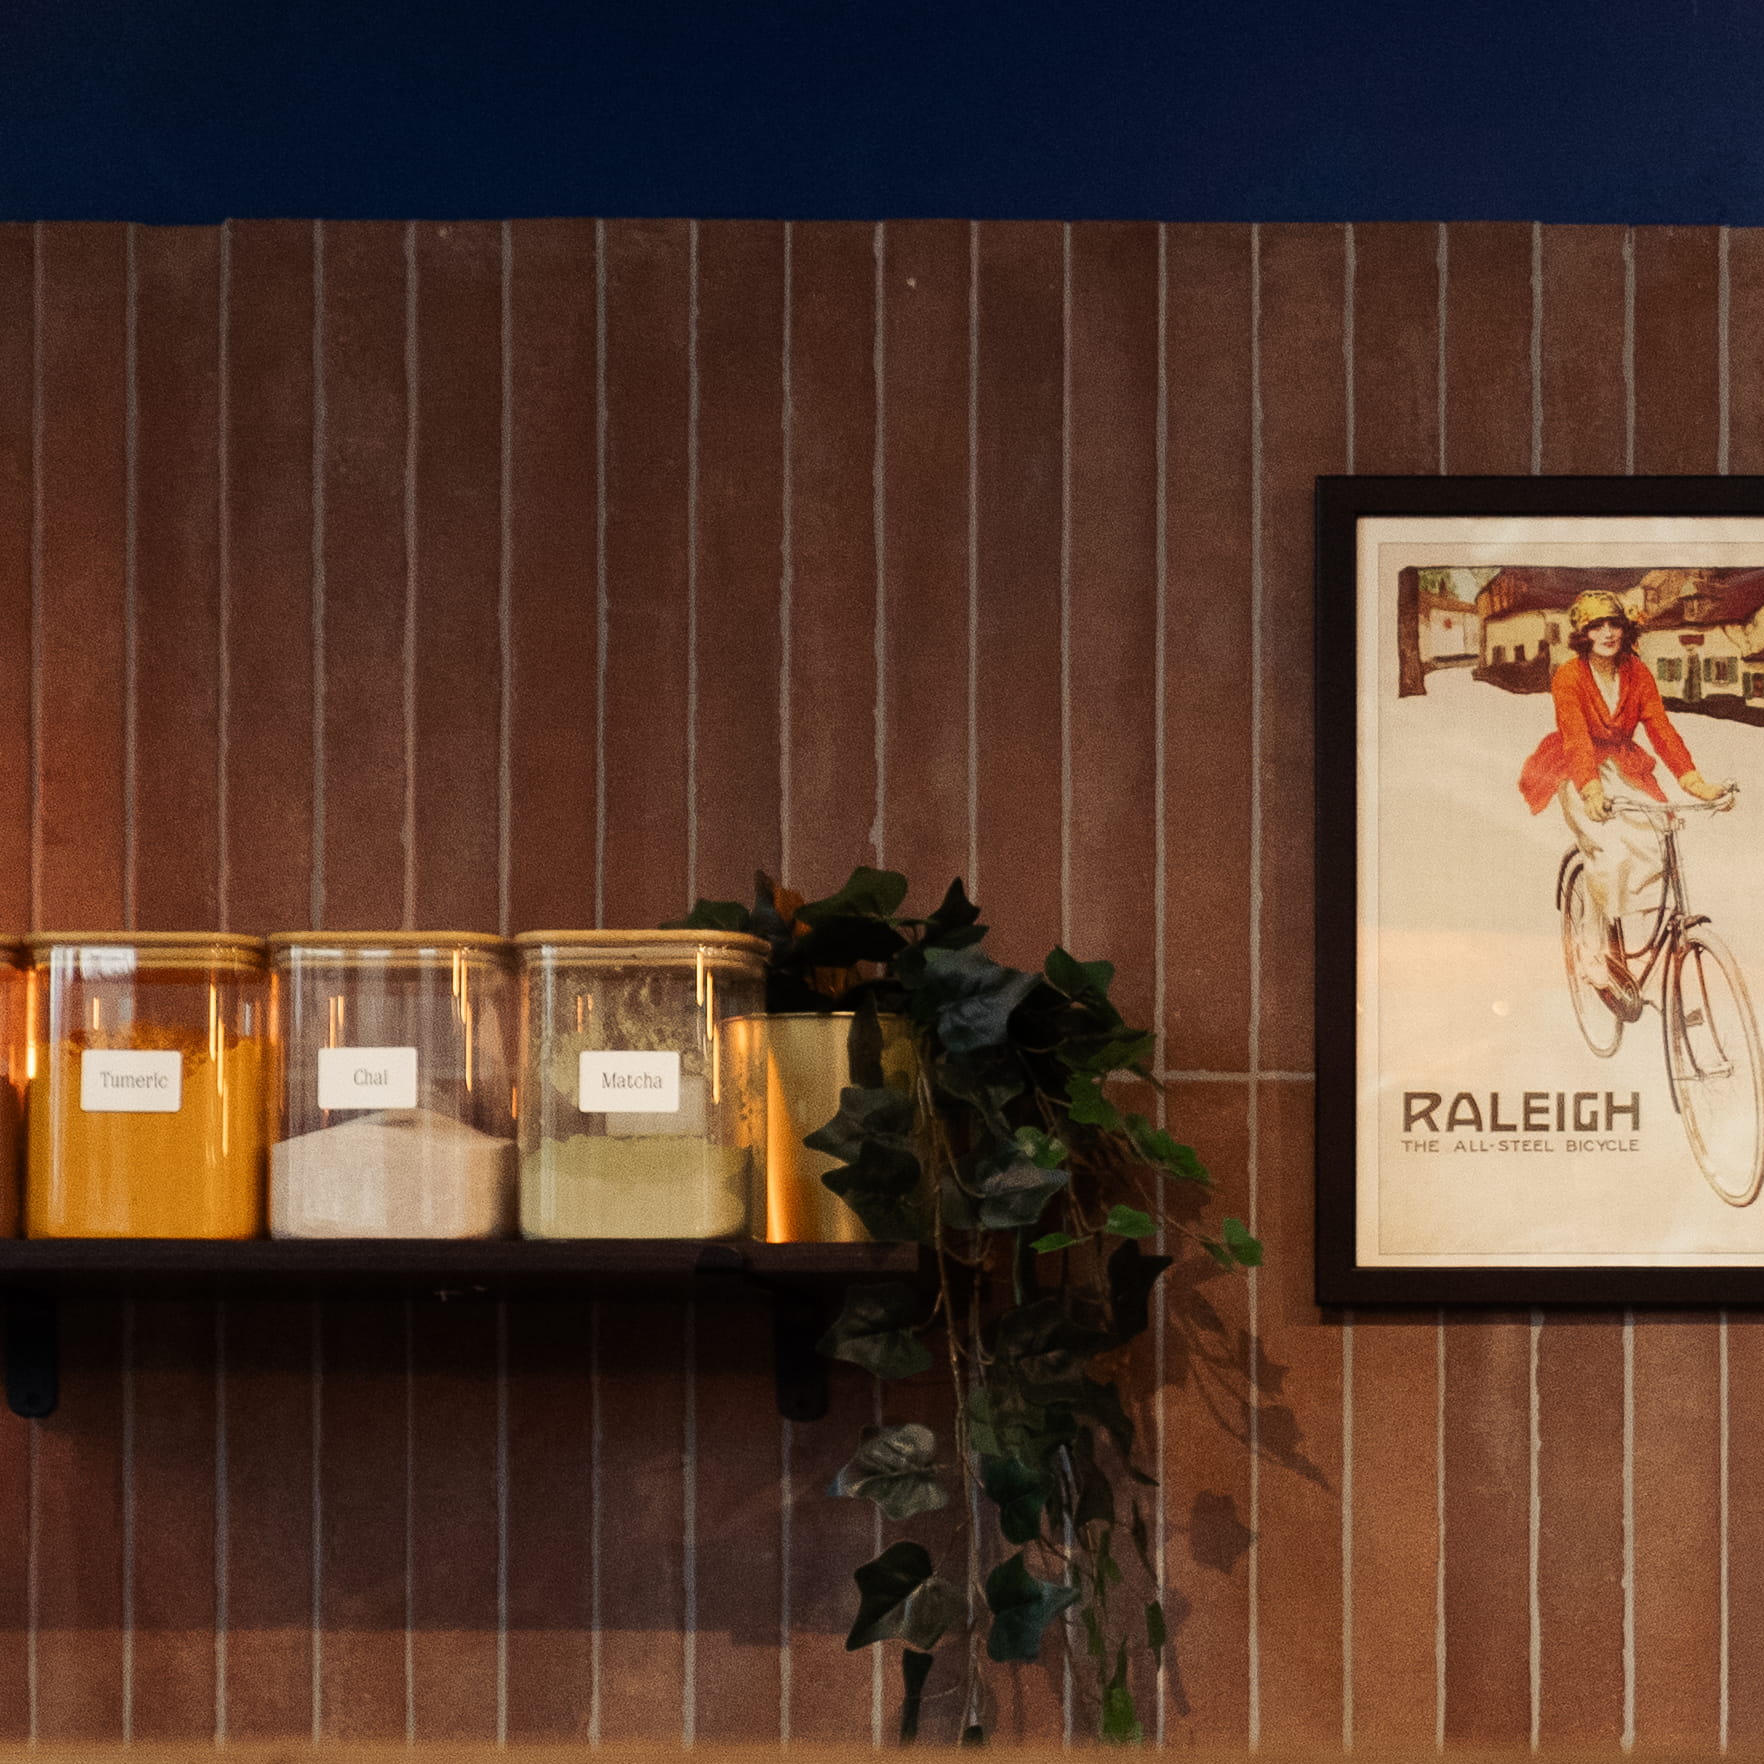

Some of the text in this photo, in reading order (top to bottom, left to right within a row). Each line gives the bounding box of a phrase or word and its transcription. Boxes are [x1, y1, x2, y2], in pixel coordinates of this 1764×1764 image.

[100, 1071, 168, 1089] Tumeric
[353, 1068, 388, 1086] Chai
[602, 1071, 663, 1089] Matcha
[1403, 1091, 1640, 1132] RALEIGH
[1401, 1139, 1640, 1153] THE ALL-STEEL BICYCLE
